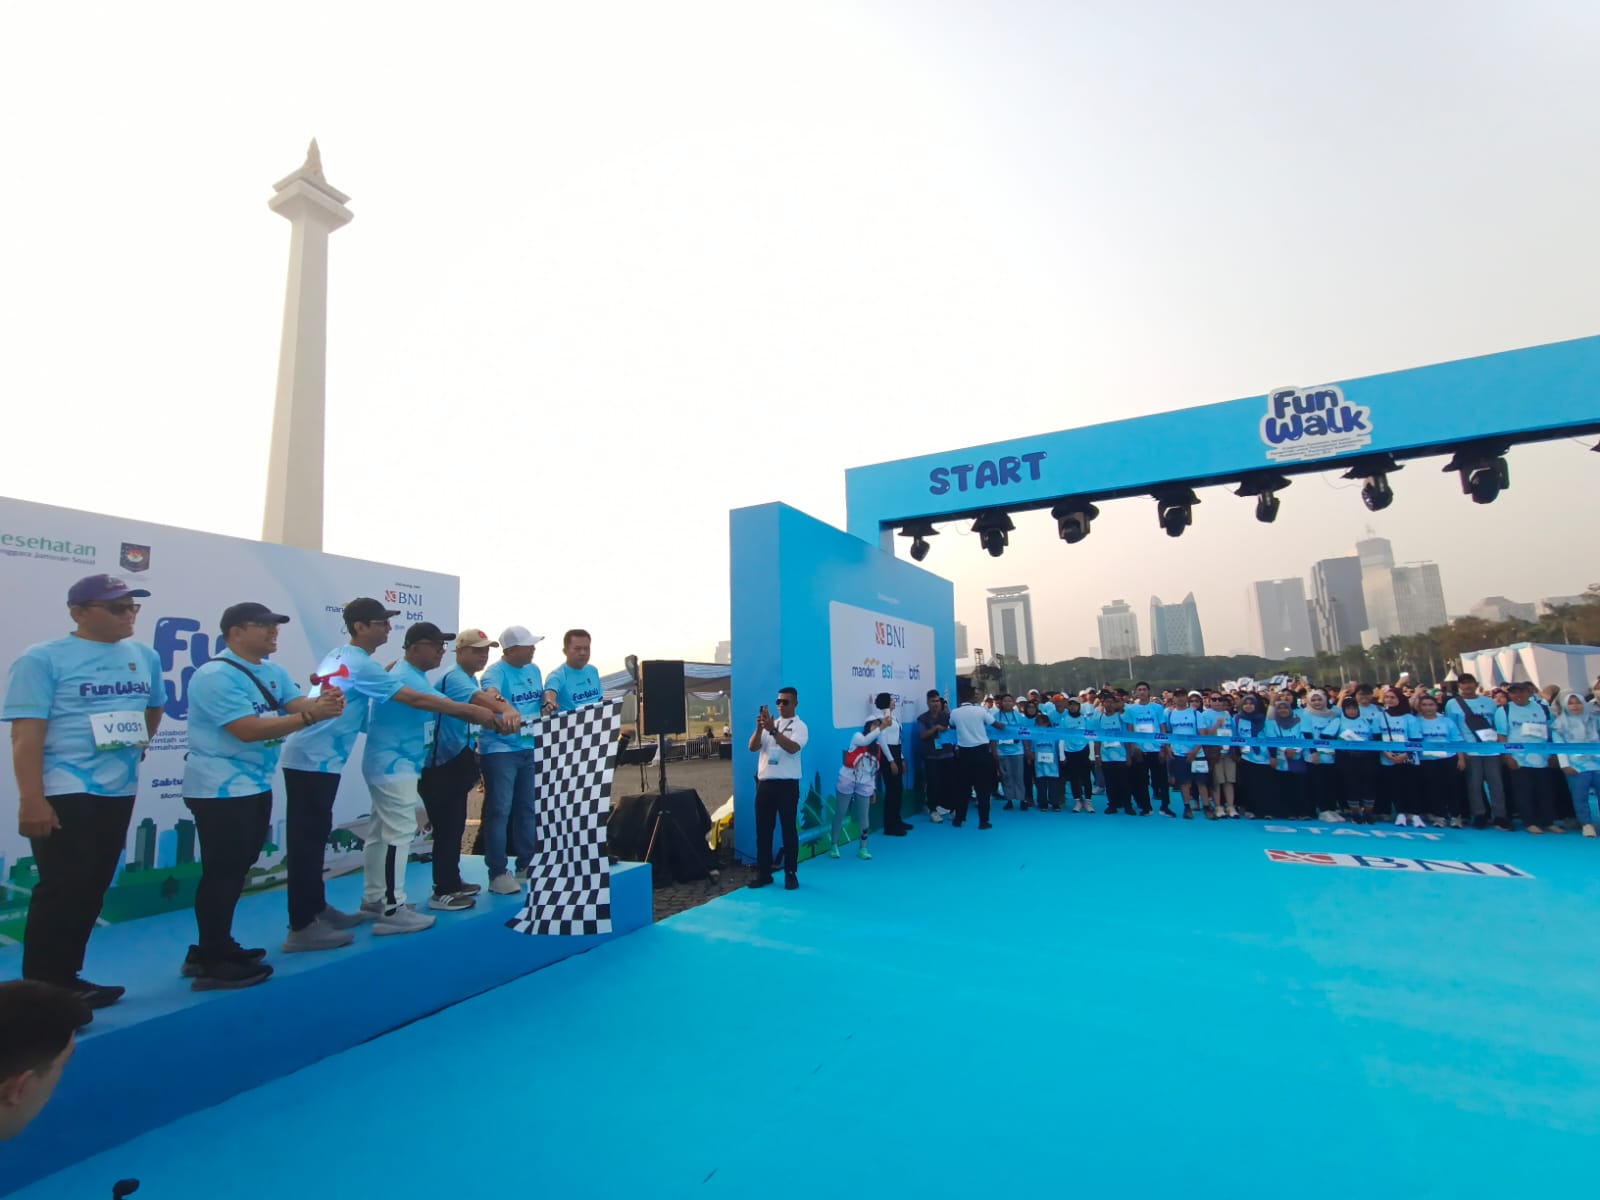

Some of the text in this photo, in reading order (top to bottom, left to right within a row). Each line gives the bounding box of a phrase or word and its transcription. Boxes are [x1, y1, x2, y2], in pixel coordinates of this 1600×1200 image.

[1273, 390, 1339, 419] Fun
[1265, 406, 1367, 444] Walk
[929, 451, 1047, 495] START
[0, 533, 97, 556] esehatan
[399, 592, 422, 606] BNI
[153, 617, 227, 672] Fu
[886, 623, 905, 649] BNI
[881, 663, 893, 680] BSI
[103, 722, 142, 734] V 0031
[1264, 825, 1446, 840] START
[1350, 855, 1524, 876] BNI
